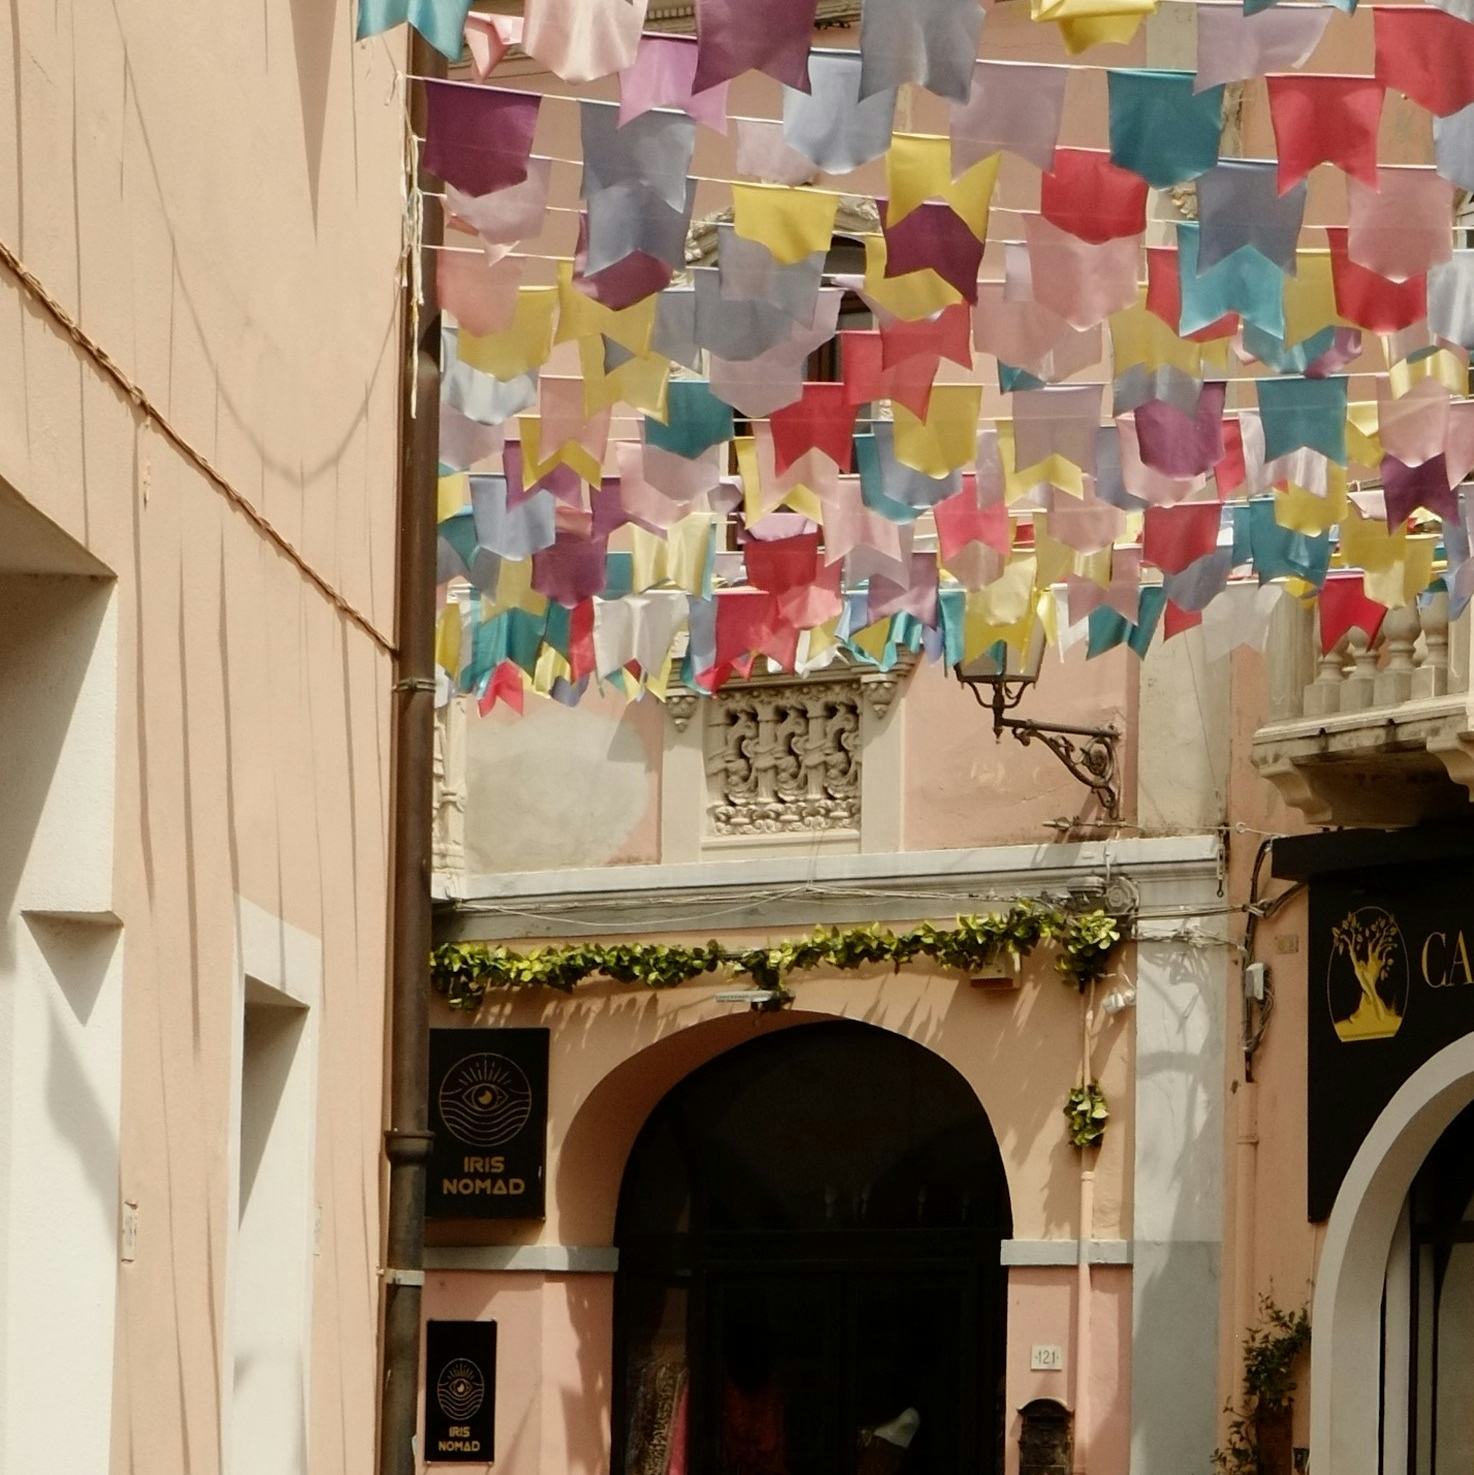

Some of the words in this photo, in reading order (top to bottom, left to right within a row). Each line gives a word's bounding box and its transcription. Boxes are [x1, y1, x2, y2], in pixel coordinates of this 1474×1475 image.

[463, 1156, 505, 1173] IRIS
[442, 1178, 525, 1195] NOMAD
[449, 1426, 470, 1437] IRIS
[438, 1440, 480, 1452] NOMAD
